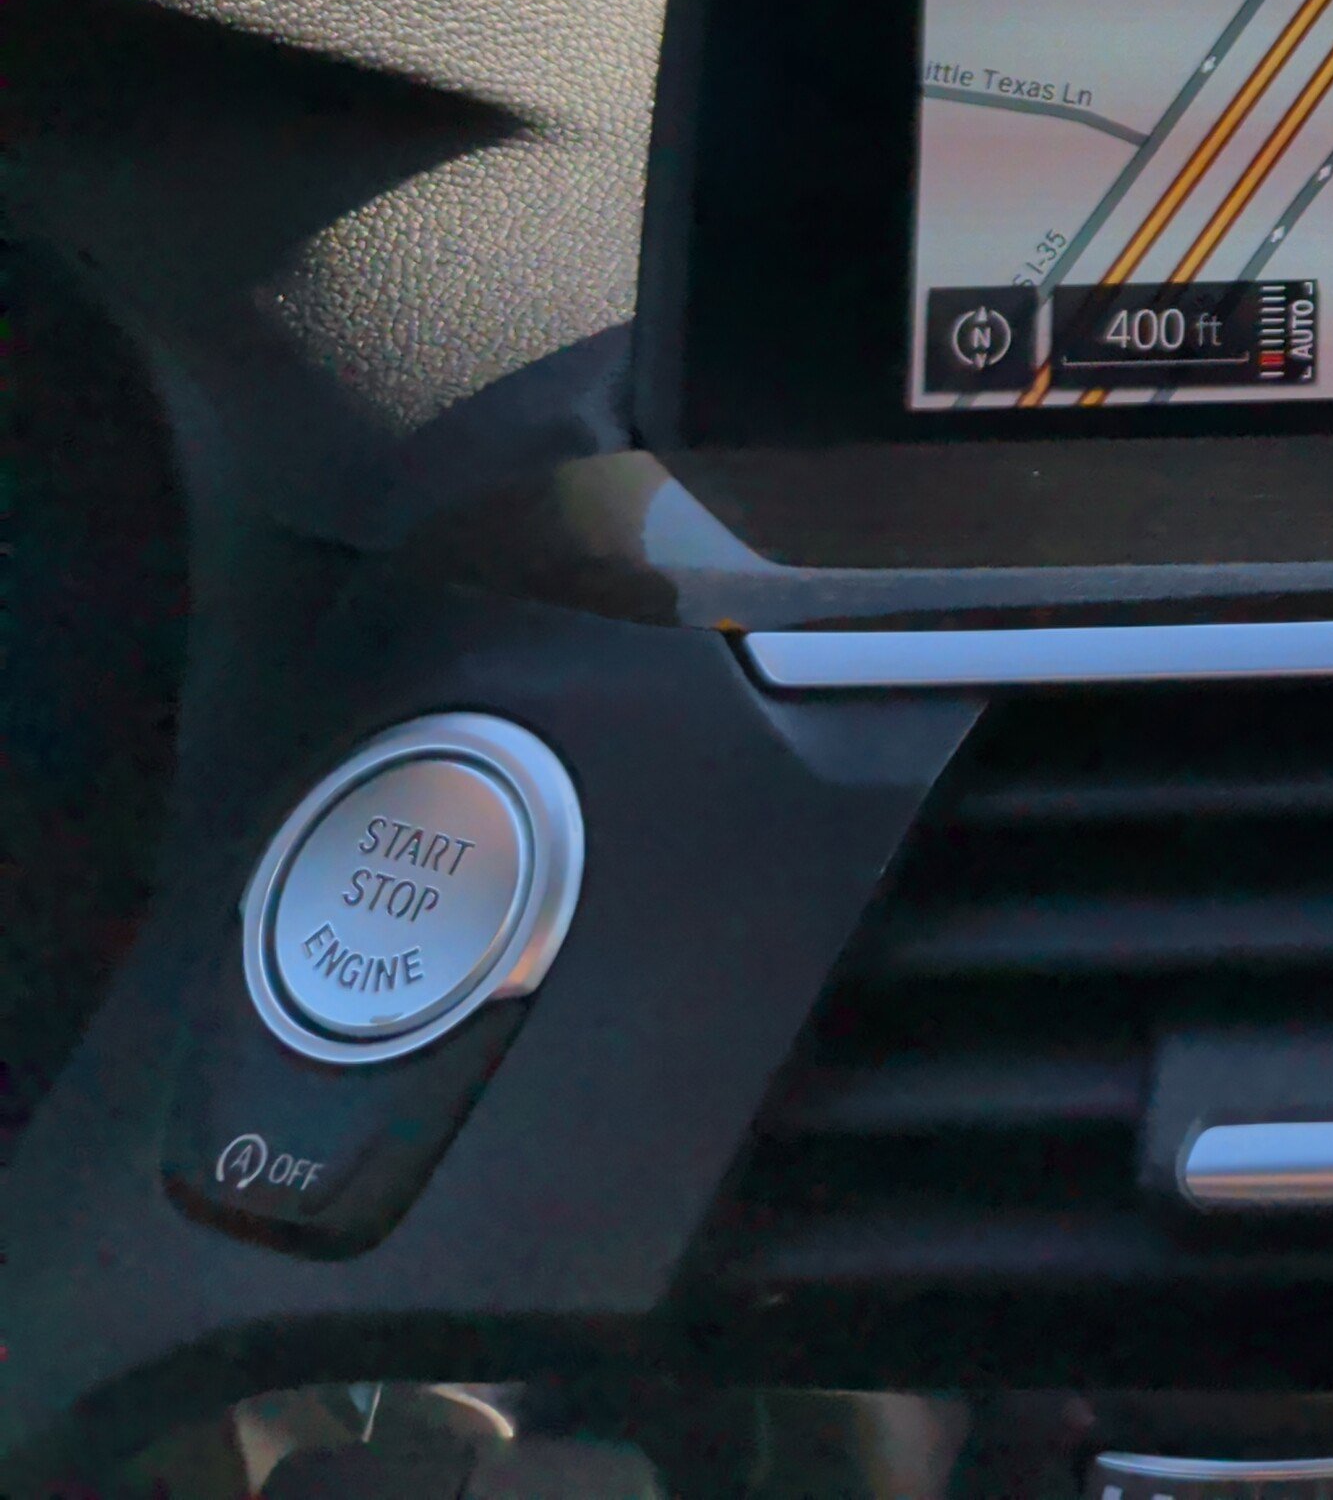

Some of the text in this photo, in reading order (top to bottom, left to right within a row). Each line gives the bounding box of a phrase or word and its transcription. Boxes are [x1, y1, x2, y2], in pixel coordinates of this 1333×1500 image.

[983, 68, 1055, 102] Texas
[1062, 82, 1093, 108] Ln
[1026, 228, 1068, 275] I-35
[972, 326, 992, 349] N
[1106, 308, 1223, 350] 400 ft
[1291, 299, 1315, 359] AUTO
[359, 816, 476, 877] START
[343, 868, 440, 924] STOP
[302, 922, 423, 994] ENGINE
[268, 1153, 325, 1191] OFF
